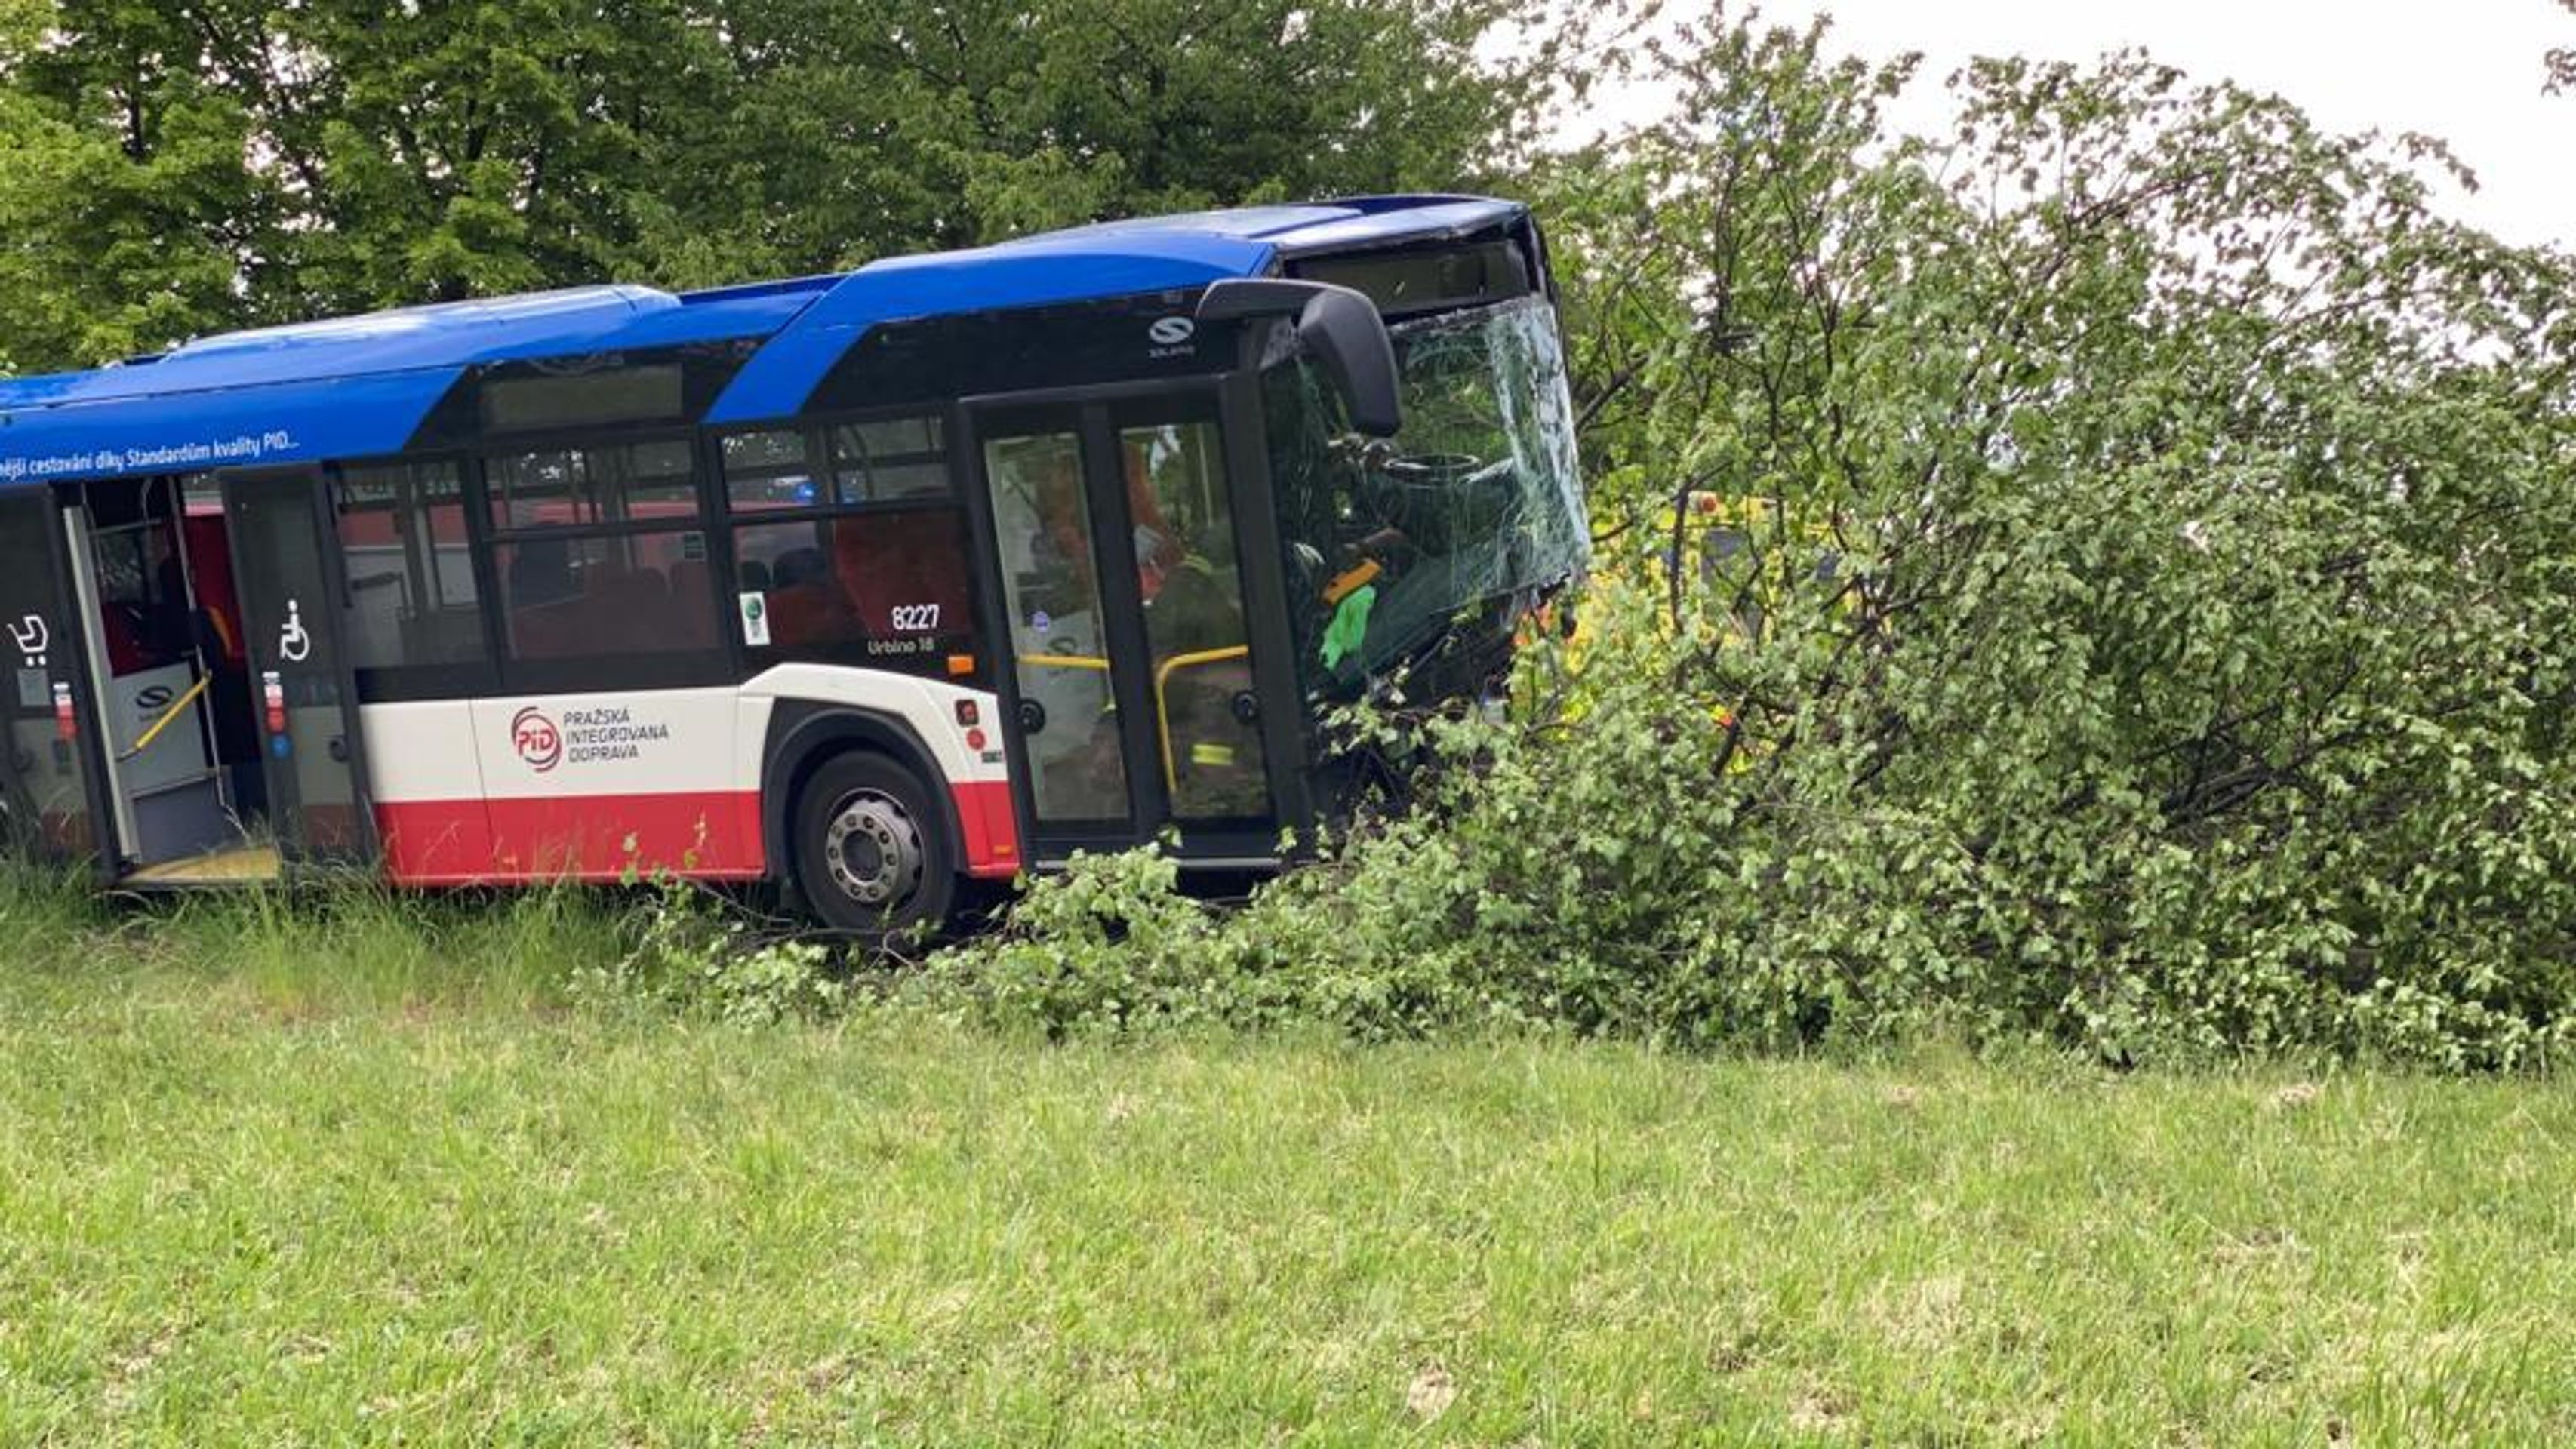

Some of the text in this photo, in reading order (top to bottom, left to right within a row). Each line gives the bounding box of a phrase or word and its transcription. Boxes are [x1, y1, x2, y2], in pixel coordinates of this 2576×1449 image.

[29, 453, 92, 475] cestování
[96, 451, 125, 472] díky
[127, 442, 211, 466] Standardům
[214, 435, 260, 457] kvality
[892, 604, 939, 630] 8227
[868, 637, 934, 655] Urbino 18
[564, 708, 629, 726] PRAŽSKÁ
[569, 744, 639, 762] DOPRAVA
